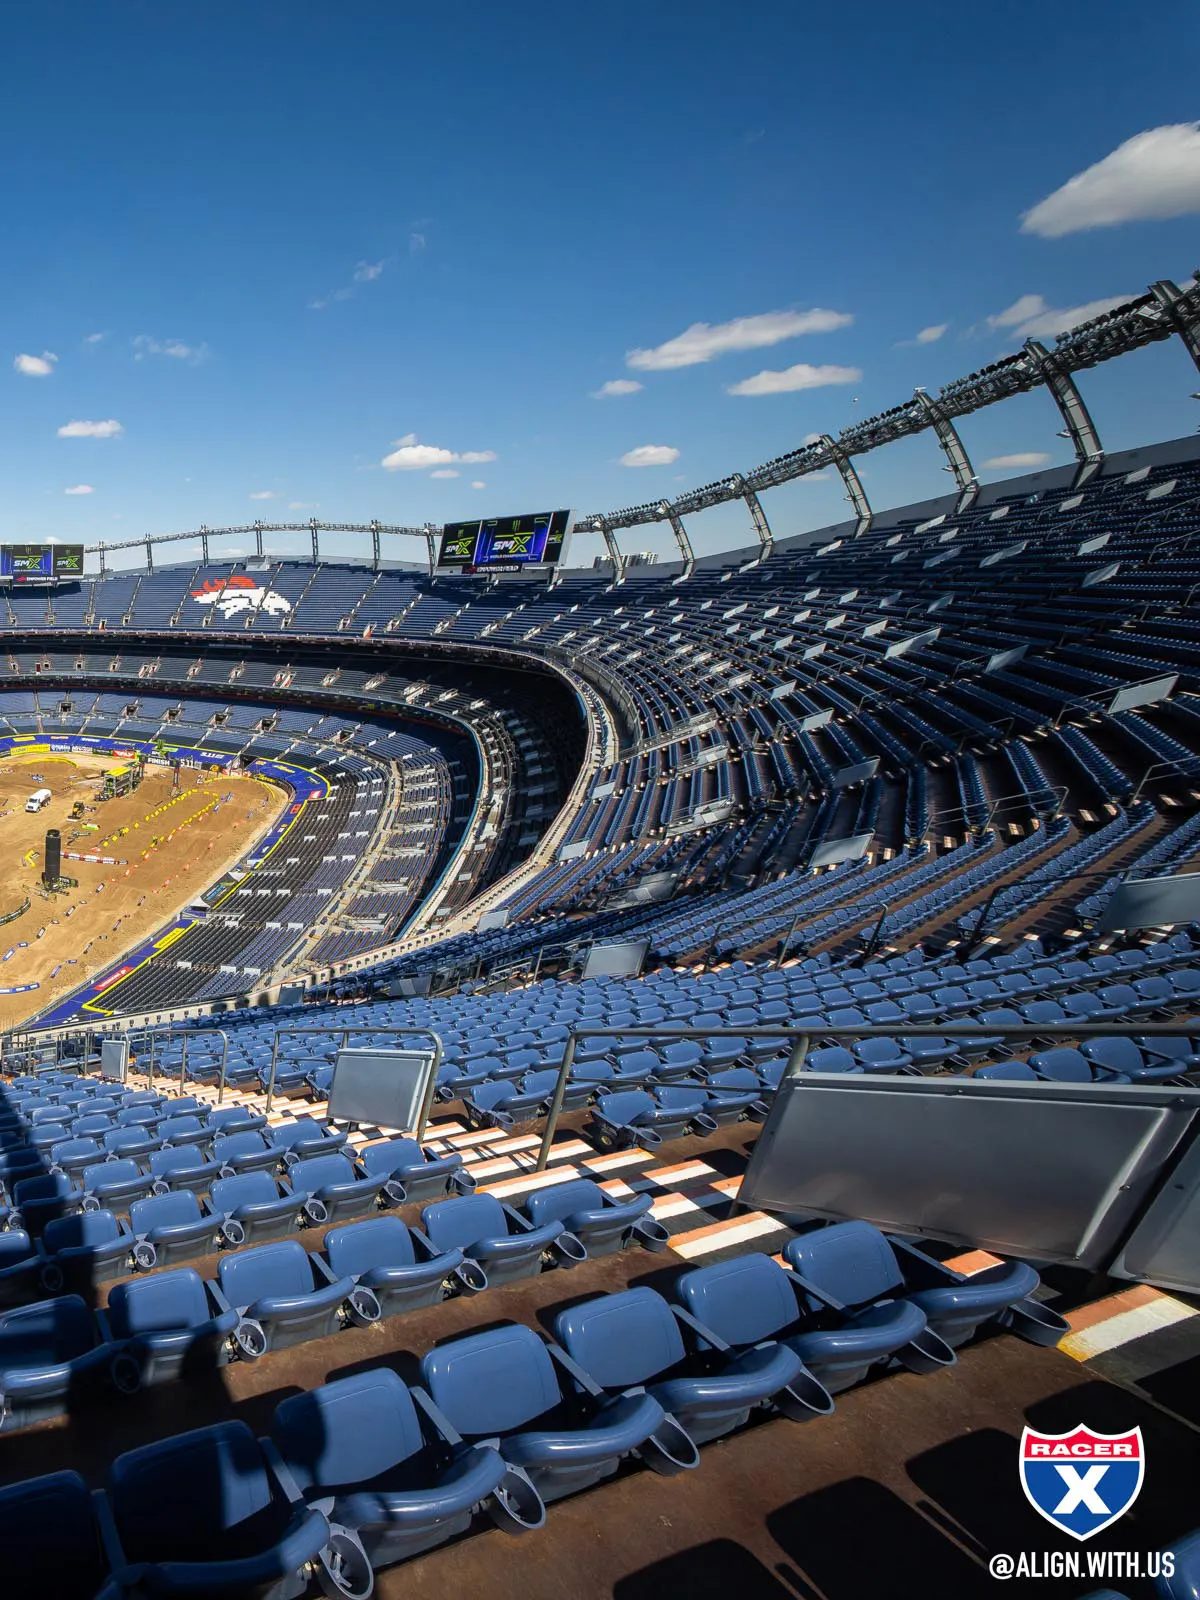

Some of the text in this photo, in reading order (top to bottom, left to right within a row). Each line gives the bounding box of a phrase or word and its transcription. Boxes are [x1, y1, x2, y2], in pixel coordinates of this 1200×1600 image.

[445, 540, 472, 555] SMX
[492, 536, 532, 554] SMX
[13, 558, 41, 569] SMX
[56, 558, 78, 568] SMX
[148, 757, 170, 766] FINISH
